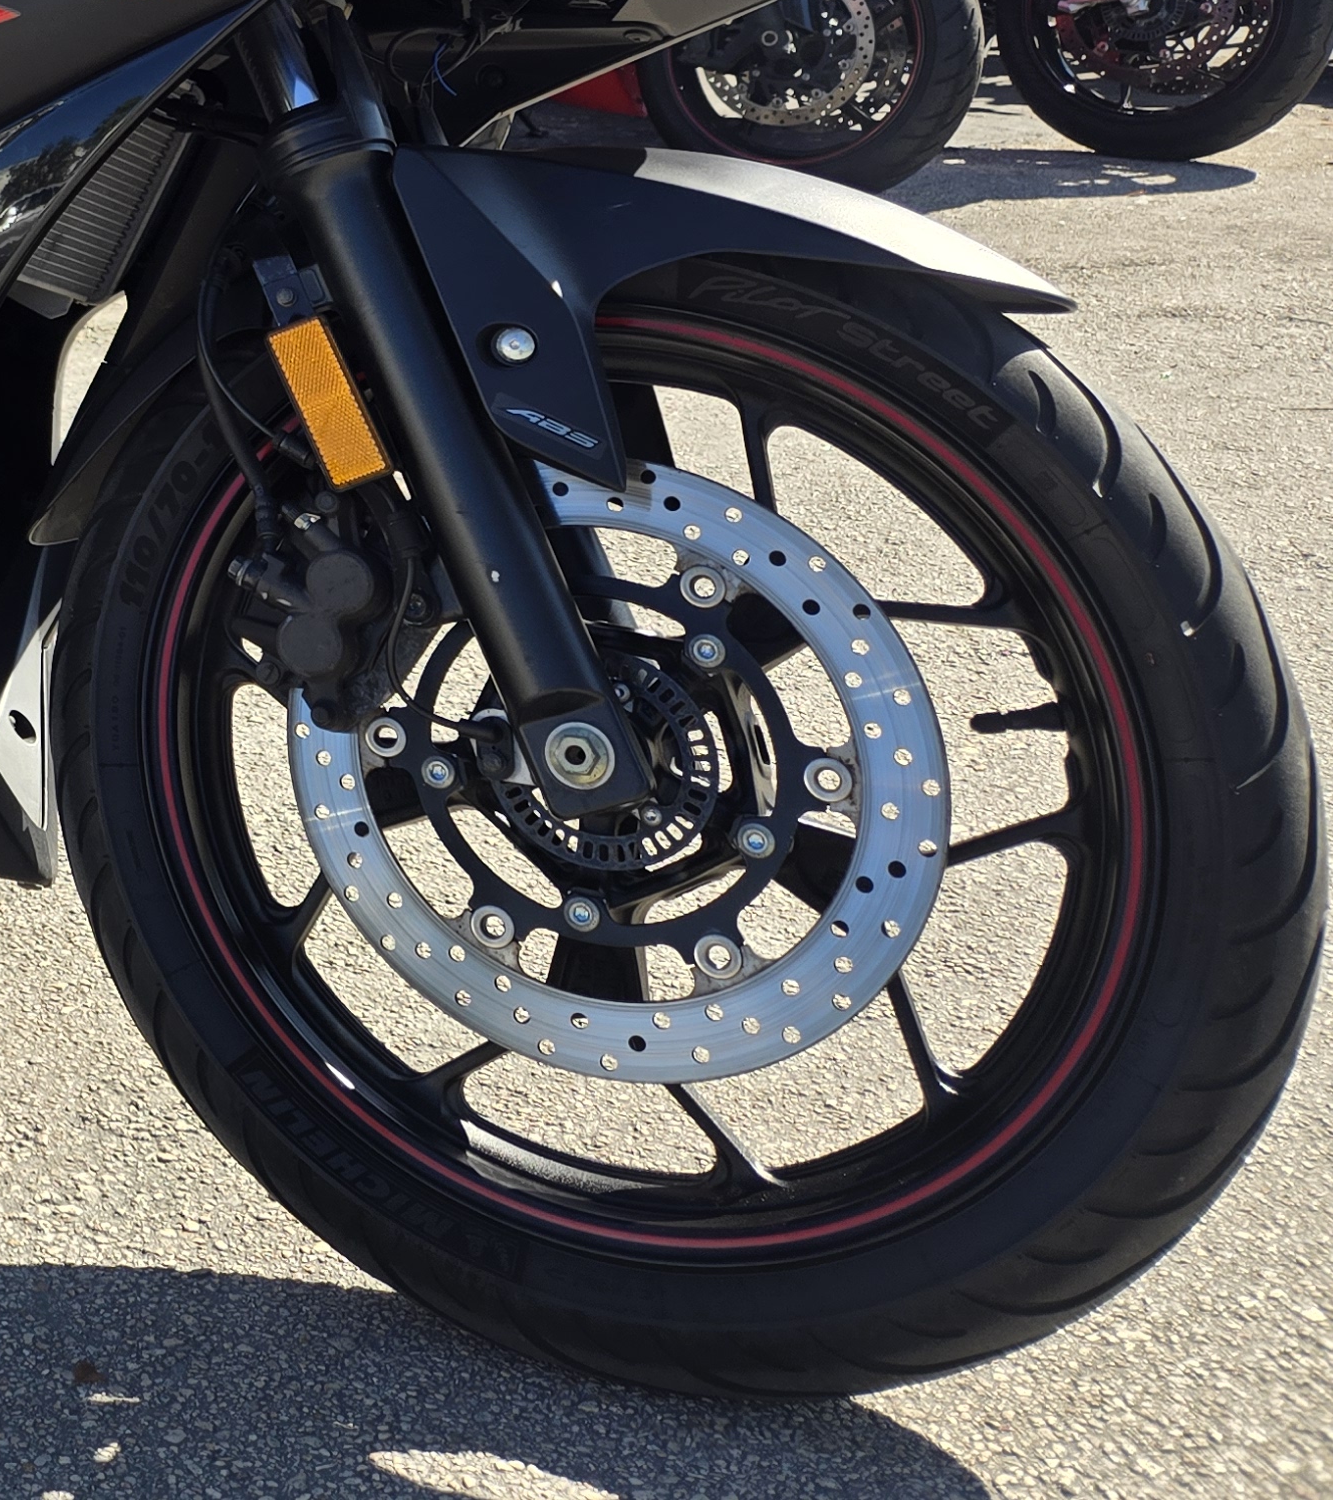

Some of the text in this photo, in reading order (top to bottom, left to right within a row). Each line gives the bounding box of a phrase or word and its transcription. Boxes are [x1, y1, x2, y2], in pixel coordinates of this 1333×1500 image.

[505, 408, 599, 449] ABS
[119, 421, 226, 608] 110/70-1
[239, 1068, 454, 1239] MICHELIN
